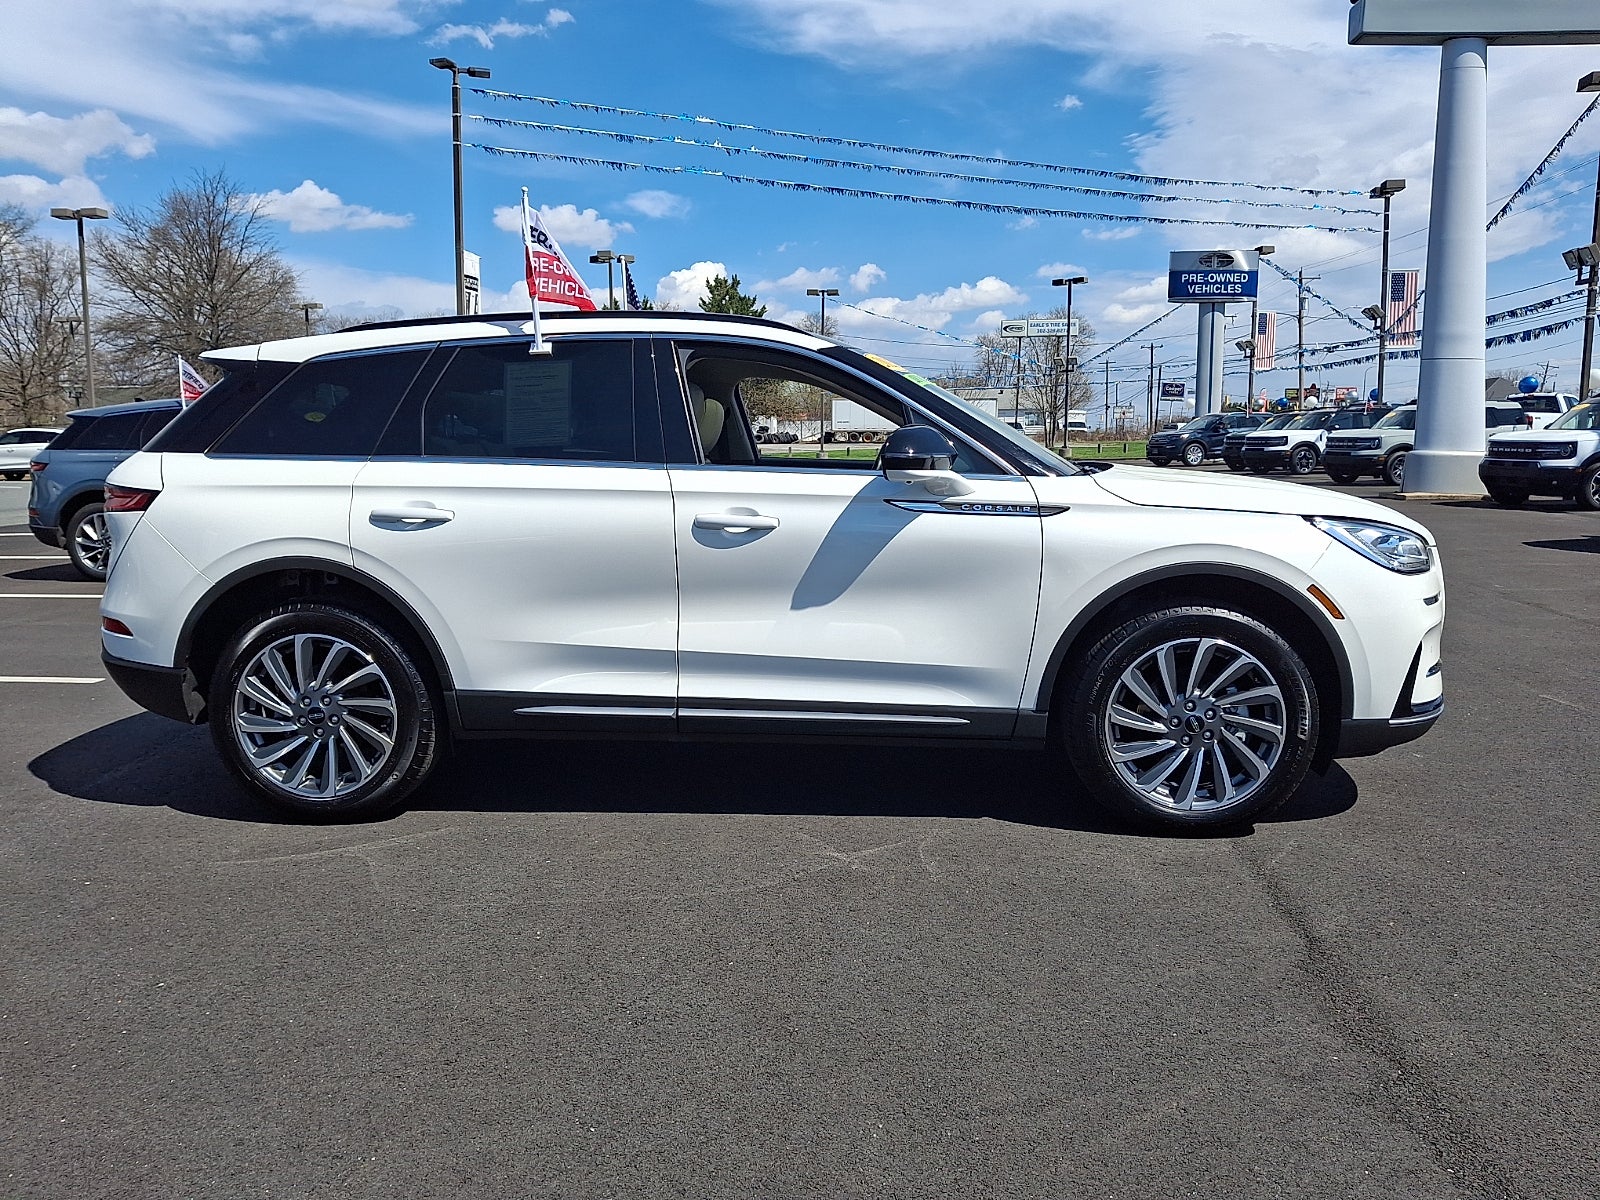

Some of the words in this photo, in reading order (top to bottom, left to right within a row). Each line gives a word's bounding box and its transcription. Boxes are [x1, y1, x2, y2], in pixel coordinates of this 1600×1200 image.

[1181, 273, 1249, 283] PRE-OWNED
[1187, 284, 1242, 294] VEHICLES
[961, 504, 1031, 513] CORSAIR
